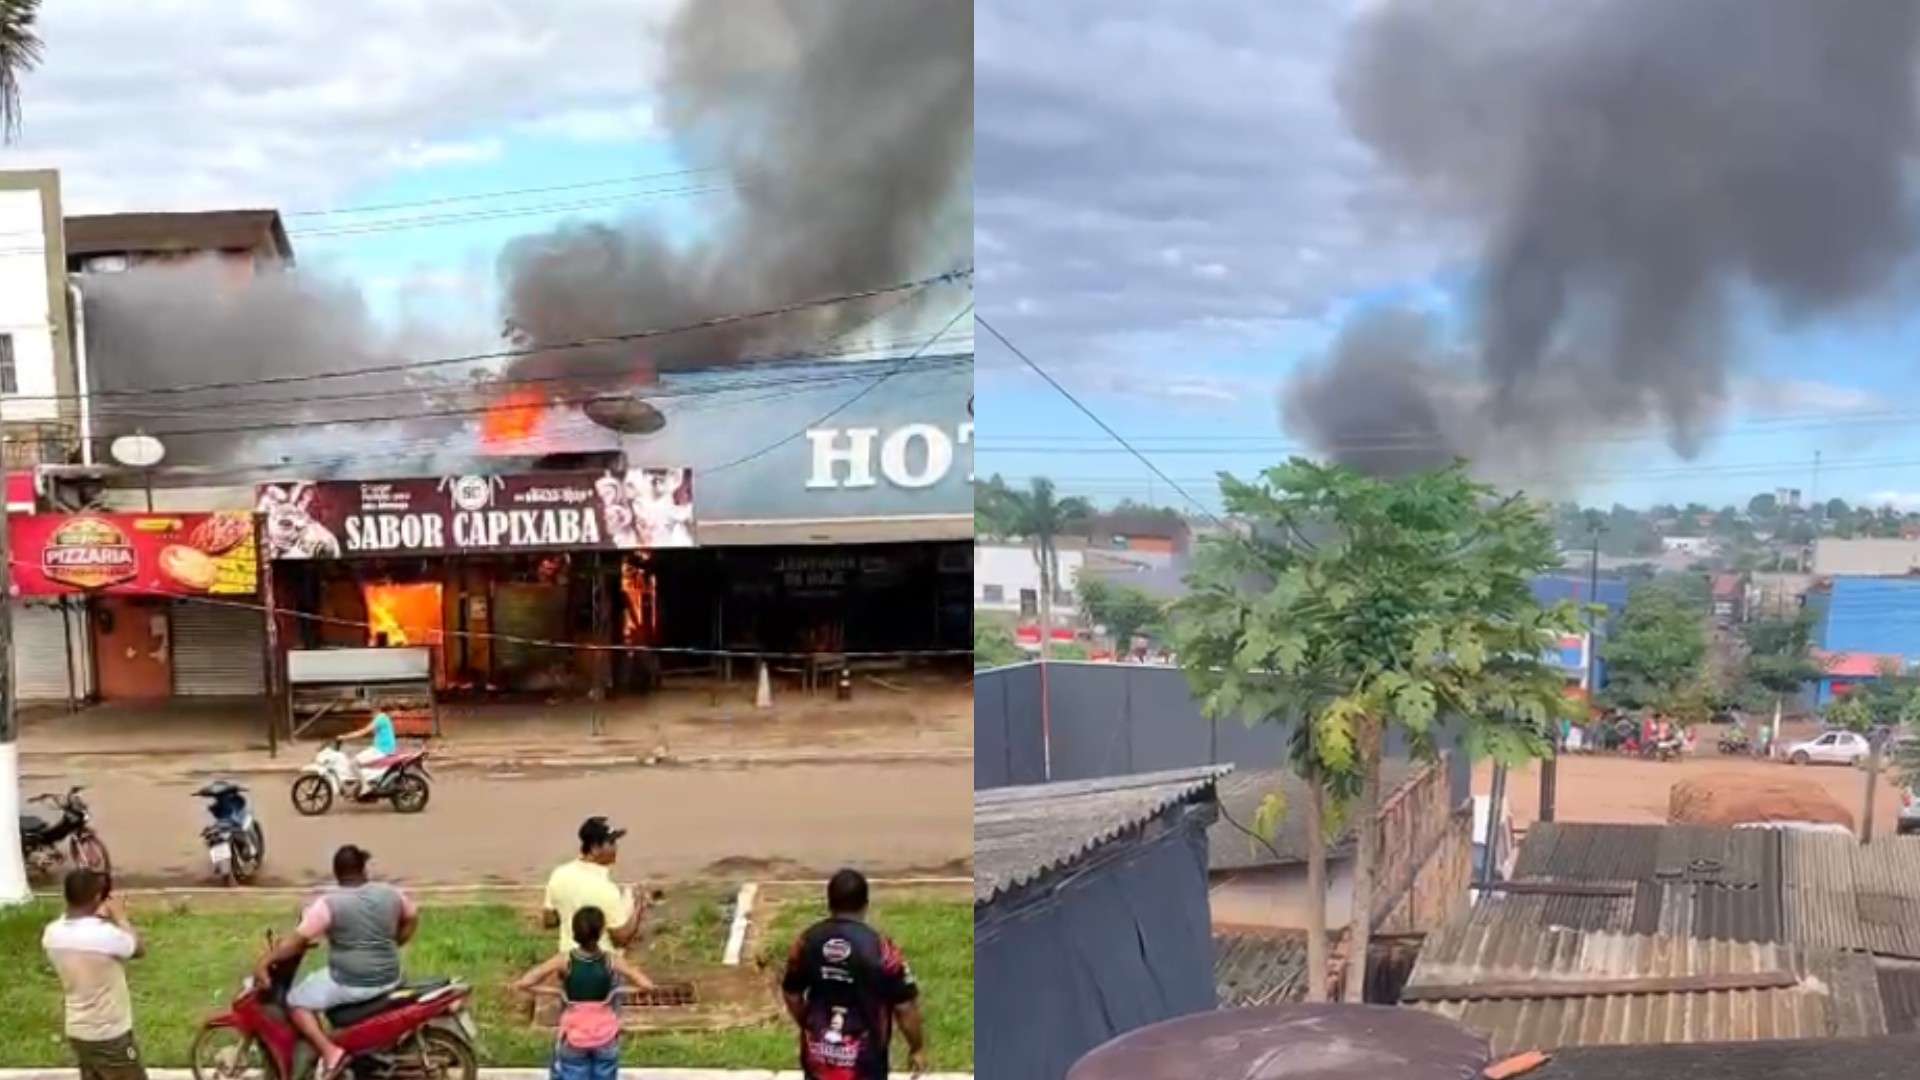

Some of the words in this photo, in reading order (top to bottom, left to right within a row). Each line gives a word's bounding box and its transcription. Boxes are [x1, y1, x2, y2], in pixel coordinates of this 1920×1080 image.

[345, 512, 444, 550] SABOR
[453, 508, 600, 548] CAPIXABA
[46, 547, 133, 565] PIZZARIA
